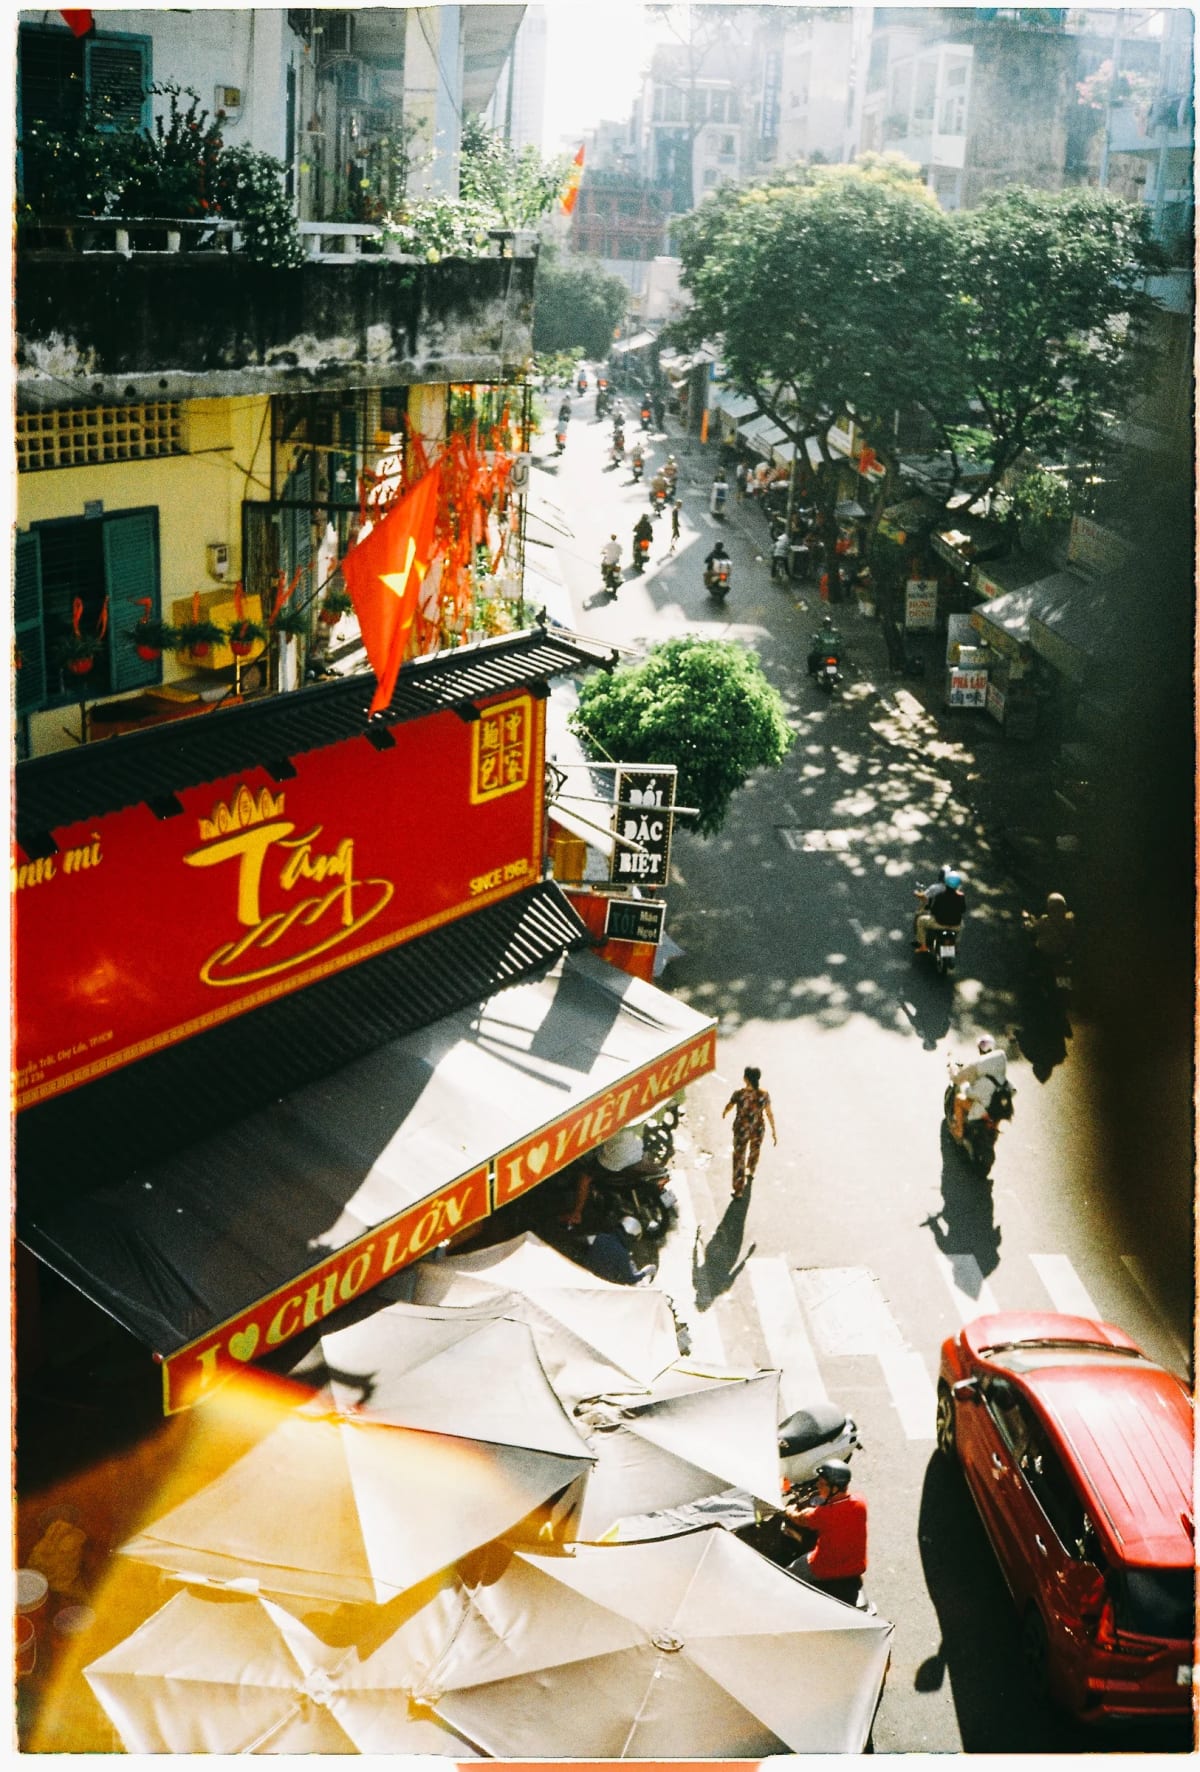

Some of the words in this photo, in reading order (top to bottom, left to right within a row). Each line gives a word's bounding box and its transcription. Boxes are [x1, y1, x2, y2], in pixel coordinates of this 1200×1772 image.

[182, 821, 354, 927] Tăng
[469, 867, 502, 896] SINCE
[505, 1155, 524, 1193] I
[553, 1082, 639, 1163] VIỆT
[640, 1040, 711, 1107] NAM
[196, 1342, 223, 1392] I
[382, 1186, 473, 1275] LỚN
